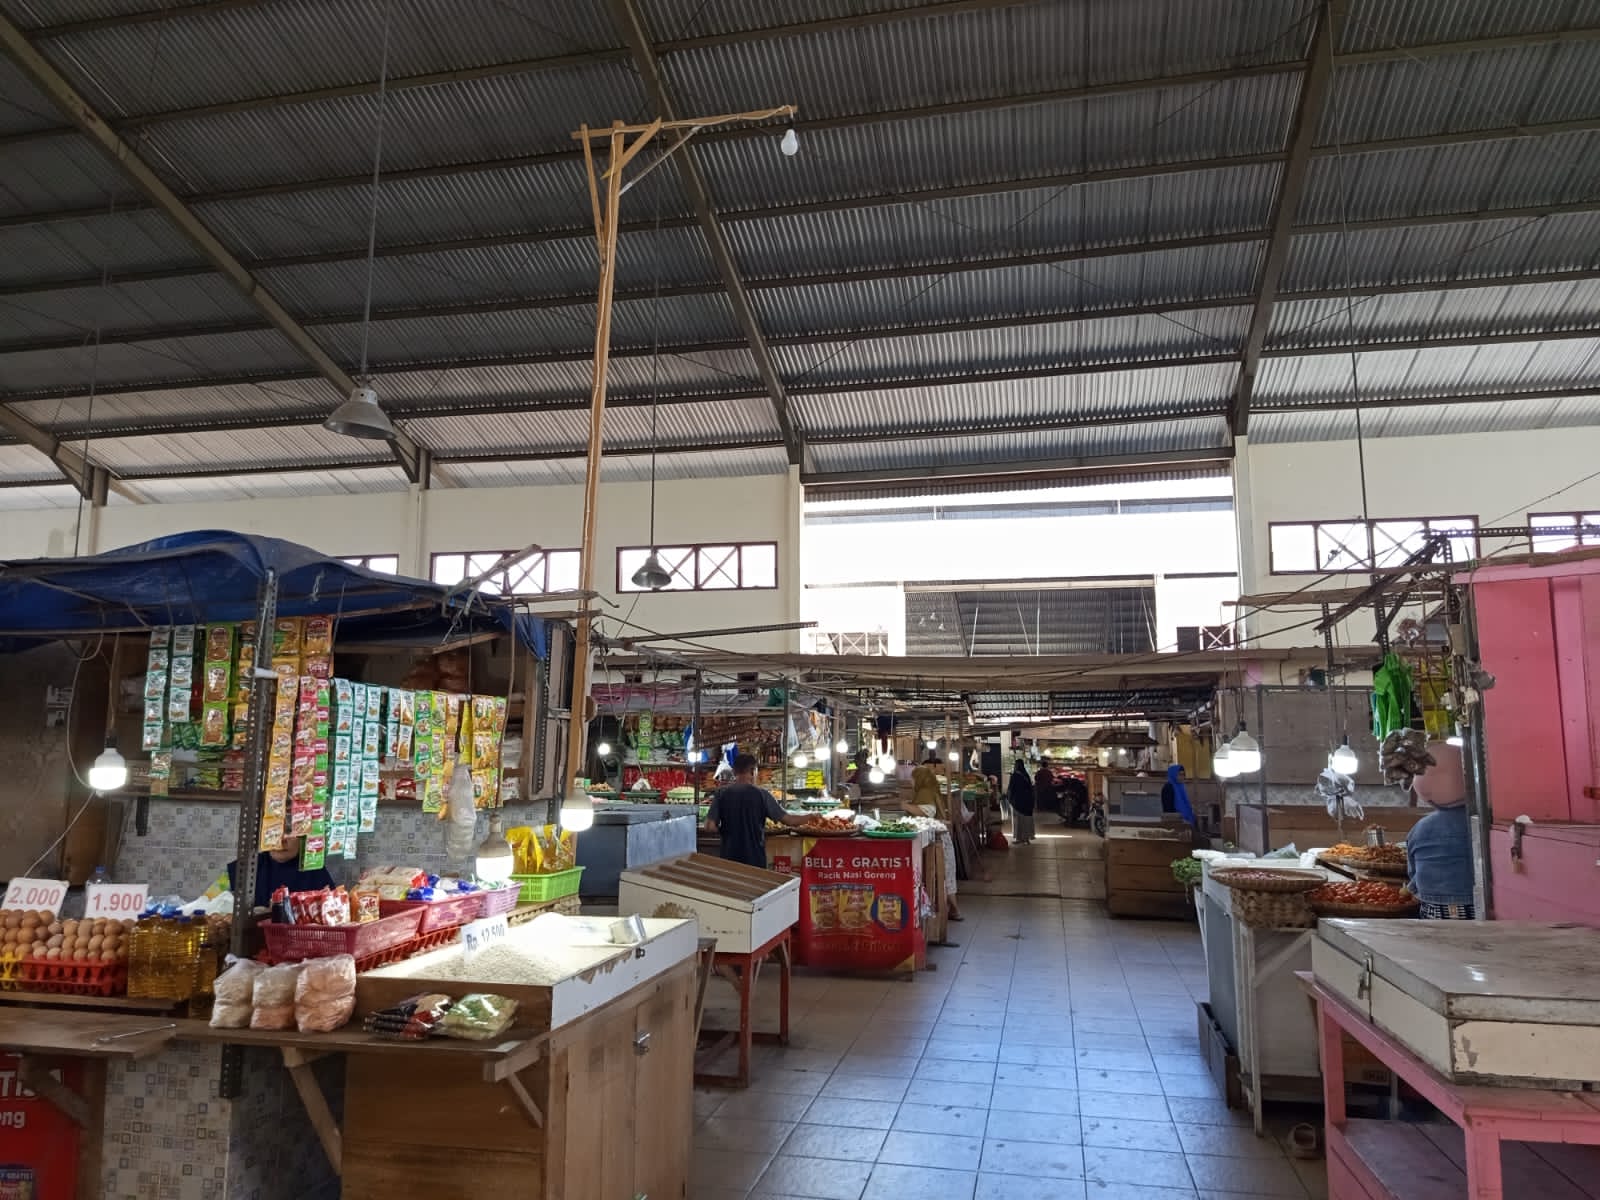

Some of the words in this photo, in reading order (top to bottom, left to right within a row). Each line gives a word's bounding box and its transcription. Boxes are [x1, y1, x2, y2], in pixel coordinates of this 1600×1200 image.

[805, 857, 832, 868] BELI
[836, 858, 844, 868] 2
[852, 857, 902, 868] GRATIS
[818, 872, 840, 880] Racik
[843, 871, 862, 879] Nasi
[864, 872, 896, 880] Goreng
[8, 886, 60, 906] 2.000
[93, 893, 143, 911] 1.900
